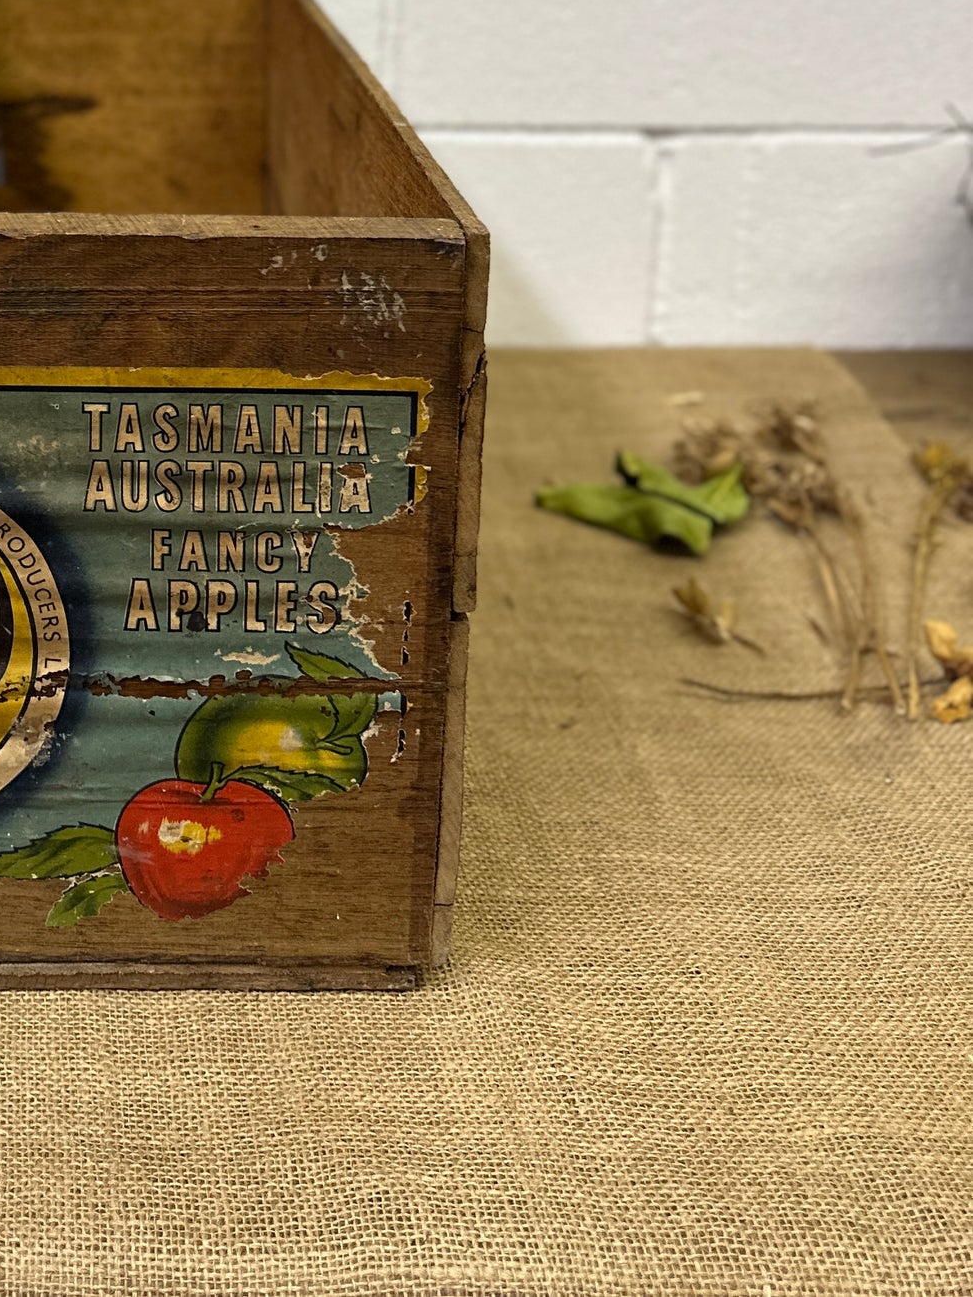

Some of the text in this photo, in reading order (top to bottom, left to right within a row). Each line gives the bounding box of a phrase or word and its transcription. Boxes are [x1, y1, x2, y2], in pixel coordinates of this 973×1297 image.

[82, 403, 369, 457] TASMANIA
[82, 460, 372, 514] AUSTRALIA
[151, 529, 321, 573] FANCY
[123, 579, 339, 634] APPLES
